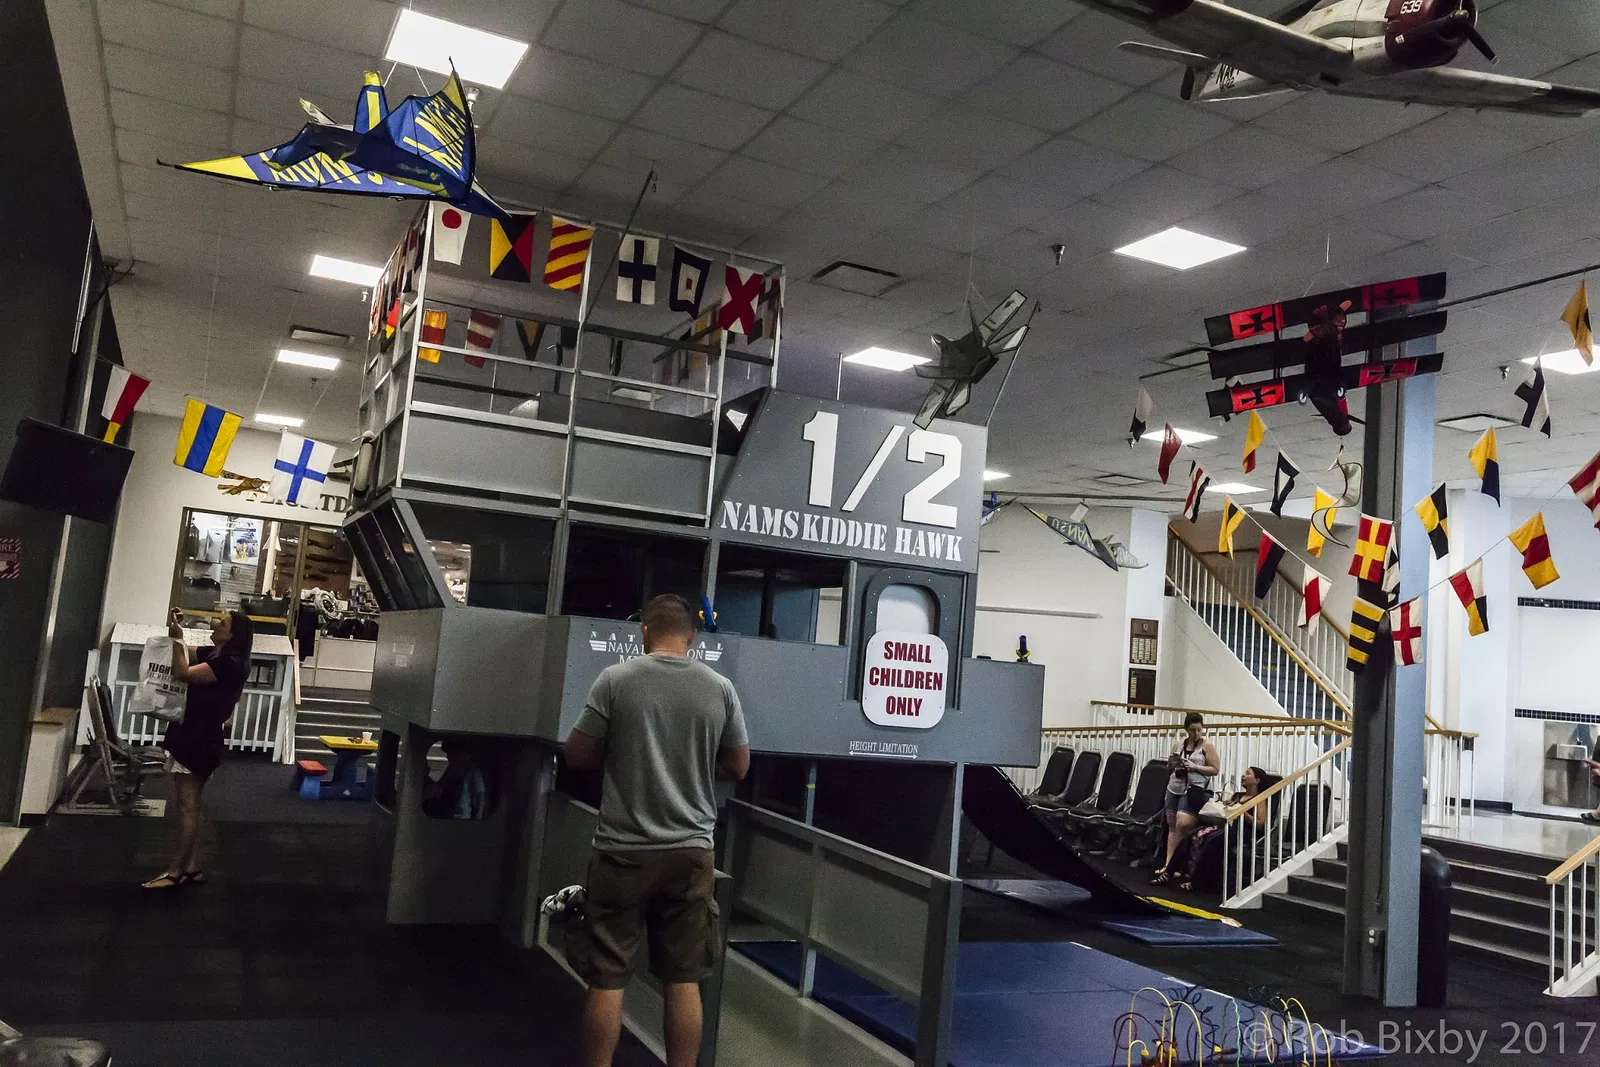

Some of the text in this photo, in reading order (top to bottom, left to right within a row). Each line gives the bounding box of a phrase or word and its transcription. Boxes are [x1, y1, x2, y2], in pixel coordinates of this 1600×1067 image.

[1400, 0, 1422, 14] 639
[804, 411, 962, 528] 1/2
[721, 500, 962, 561] NAMS KIDDIE HAWK
[591, 631, 723, 650] NATAL
[884, 641, 931, 663] SMALL
[869, 667, 943, 690] CHILDREN
[886, 696, 922, 716] ONLY
[850, 741, 918, 754] HEIGHT LIMITATION
